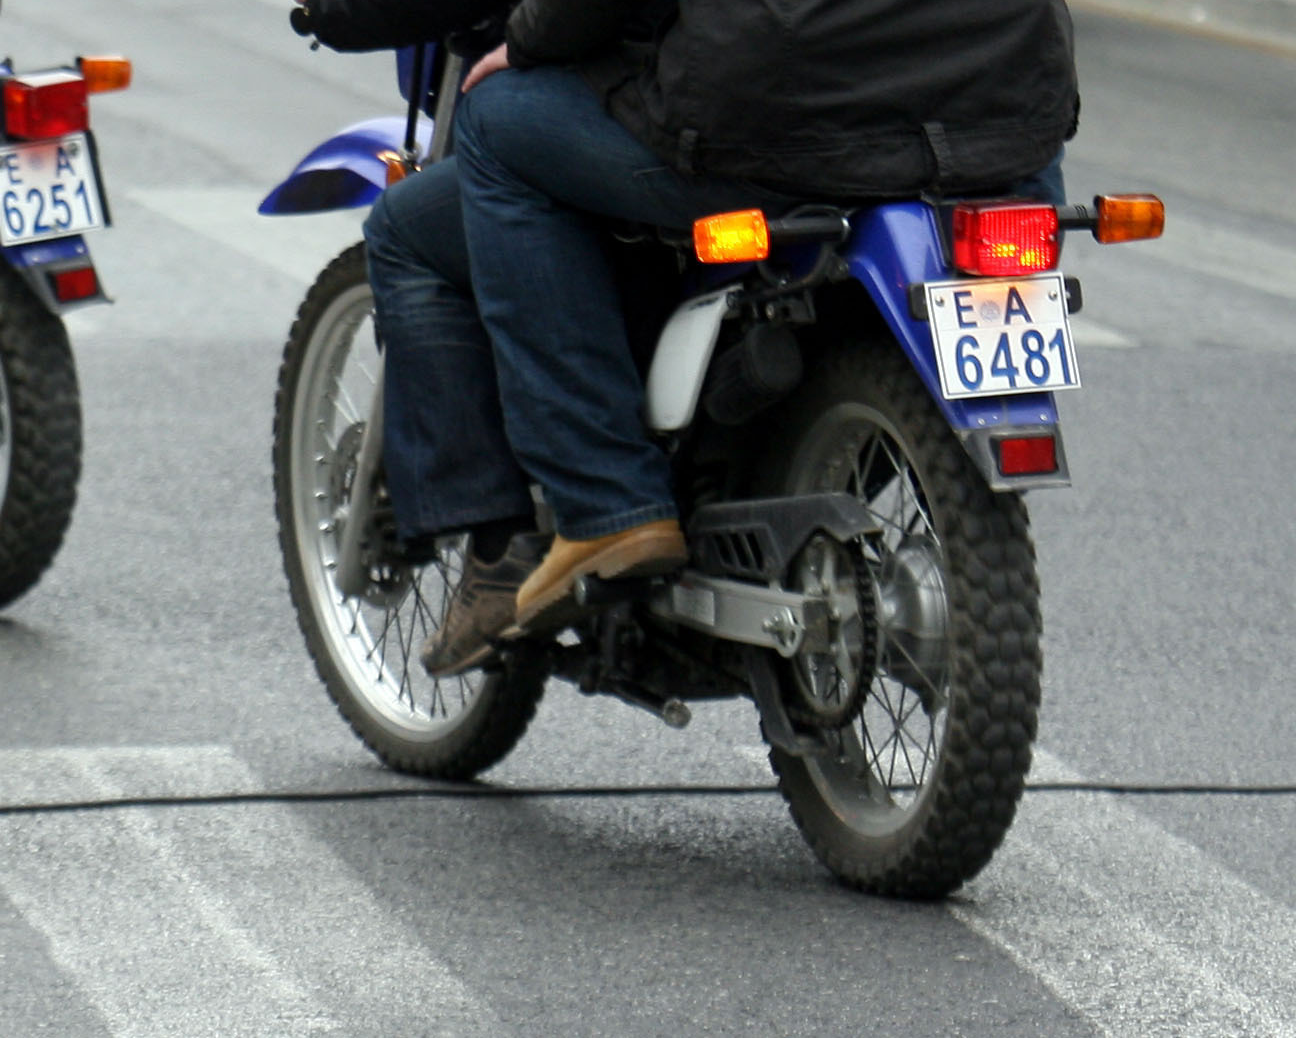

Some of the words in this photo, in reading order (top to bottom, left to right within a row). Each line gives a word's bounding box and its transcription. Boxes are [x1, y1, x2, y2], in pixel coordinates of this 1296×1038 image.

[4, 152, 23, 185] E
[55, 146, 75, 179] A
[2, 179, 93, 237] 6251
[952, 290, 979, 329] E
[1003, 285, 1033, 326] A
[955, 327, 1073, 391] 6481
